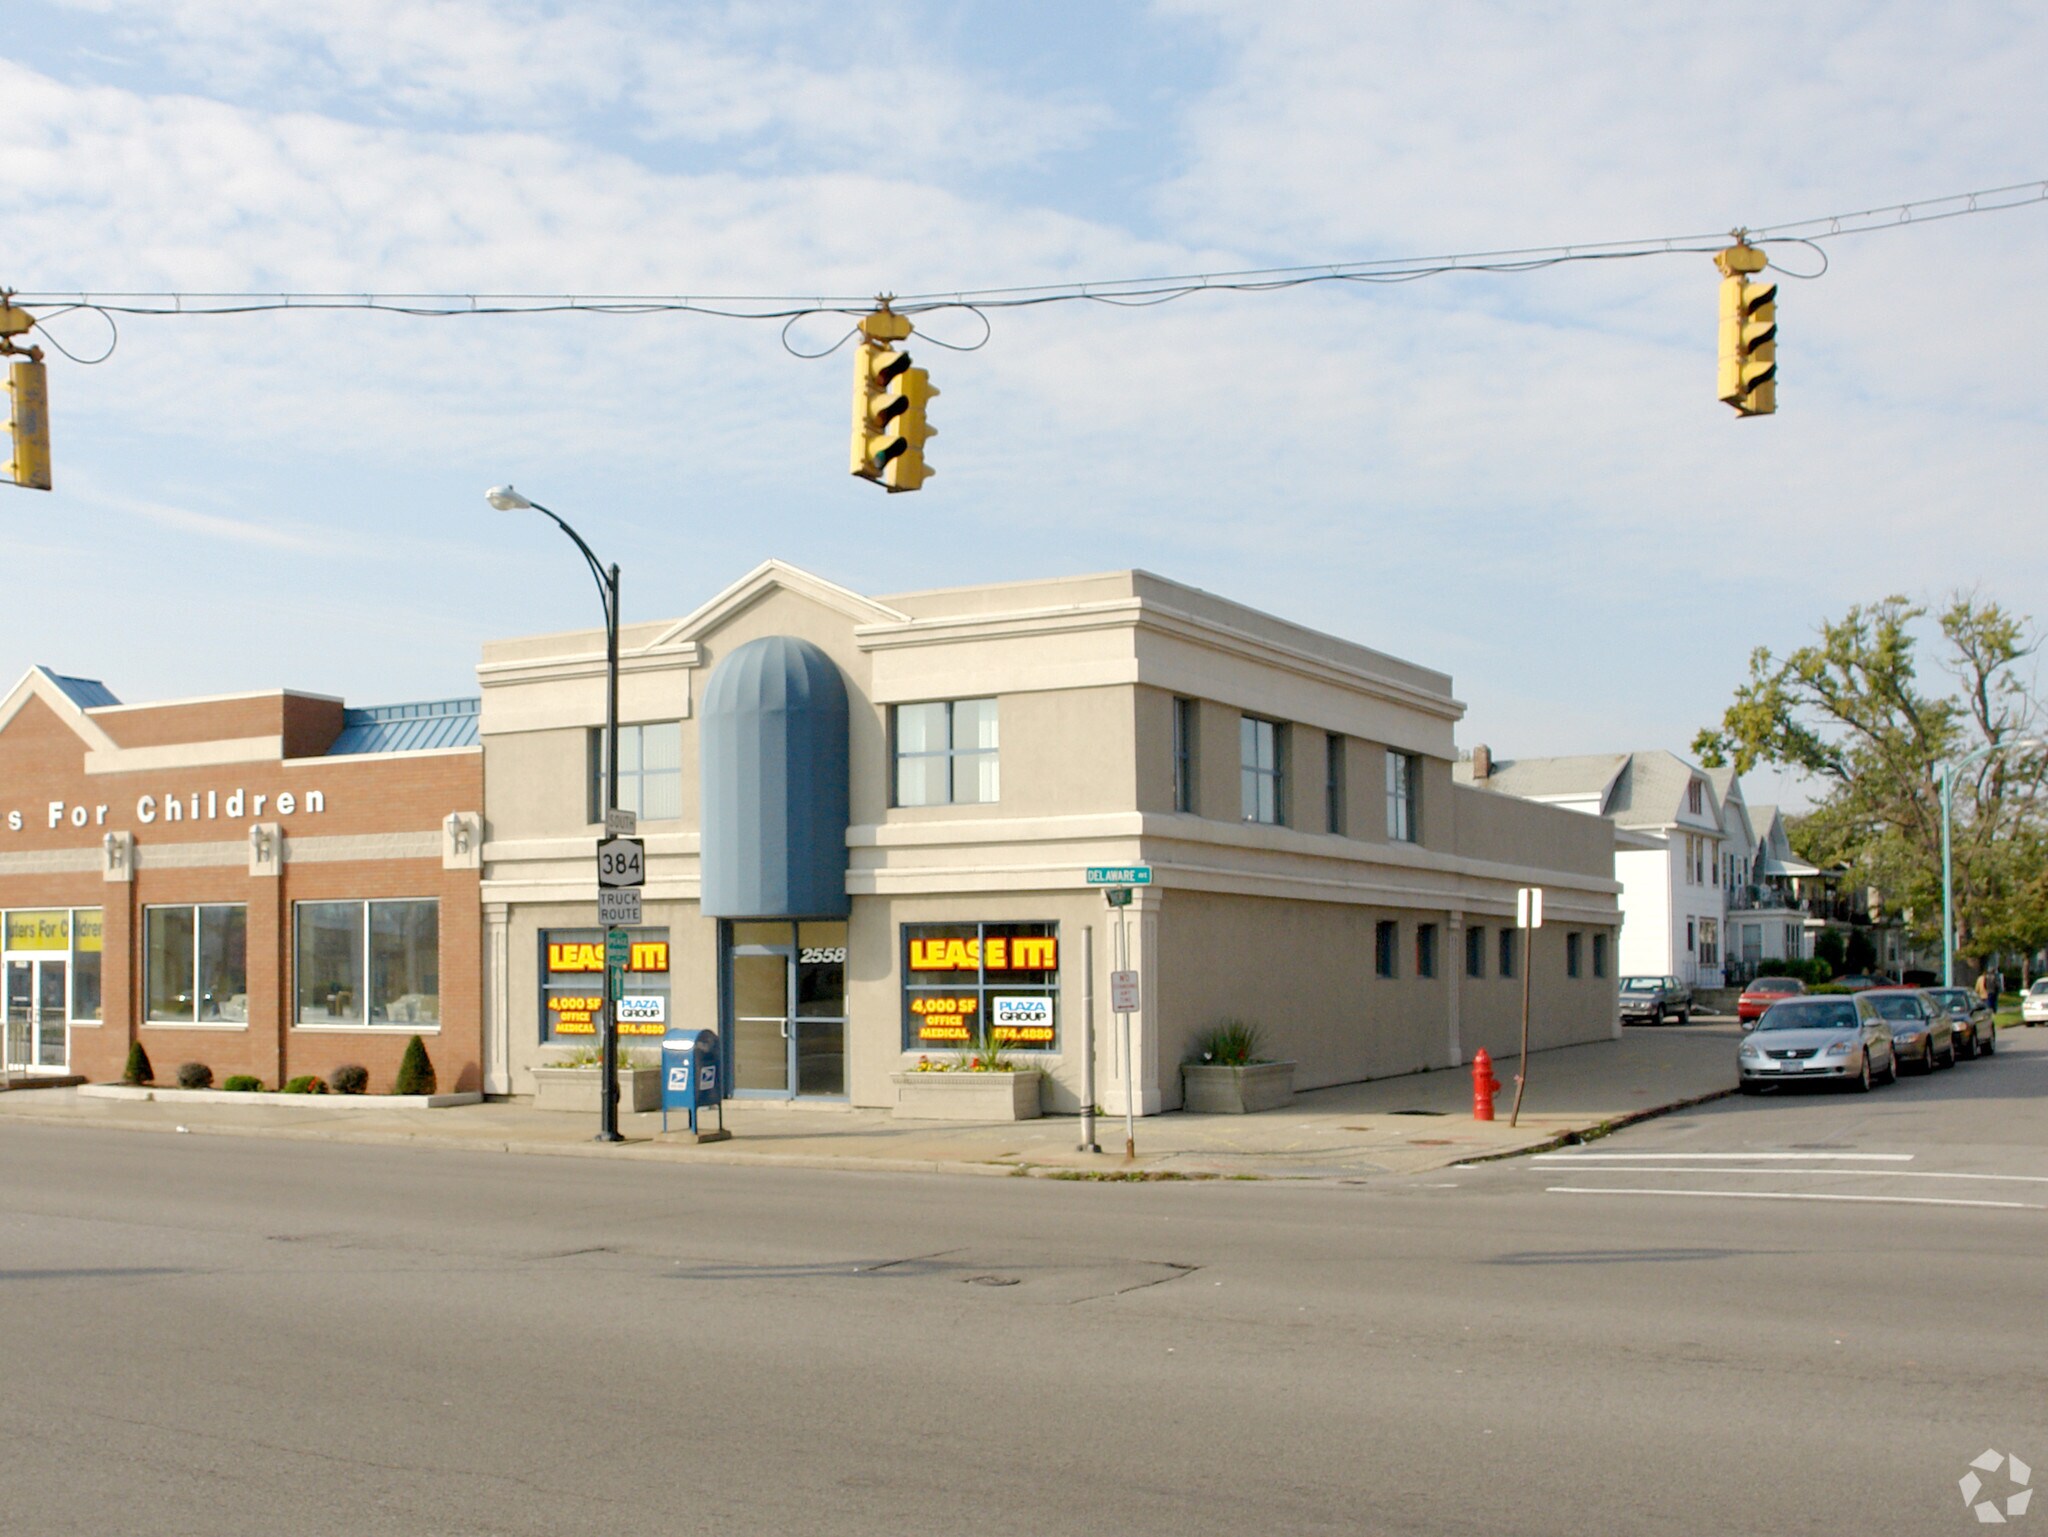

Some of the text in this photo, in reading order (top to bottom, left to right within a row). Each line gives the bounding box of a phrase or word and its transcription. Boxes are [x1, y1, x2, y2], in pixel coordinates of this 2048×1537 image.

[48, 801, 109, 829] For
[136, 788, 325, 823] Children
[609, 814, 634, 828] SOUTH
[602, 853, 640, 875] 384
[1087, 869, 1136, 882] DELAWARE
[600, 893, 640, 905] TRUCK
[601, 908, 640, 920] ROUTE
[38, 919, 57, 938] For
[548, 942, 628, 972] LEAS
[631, 942, 668, 972] IT!
[800, 947, 847, 964] 2558
[910, 937, 1057, 971] LEASE IT!
[548, 996, 602, 1011] 4,000 SF
[621, 1000, 660, 1009] PLAZA
[911, 998, 978, 1014] 4,000 SF
[999, 1001, 1046, 1011] PLAZA
[560, 1011, 591, 1022] OFFICE
[622, 1009, 660, 1018] GROUP
[1000, 1012, 1047, 1021] GROUP
[925, 1015, 964, 1026] OFFICE
[555, 1023, 596, 1034] MEDICAL
[919, 1028, 970, 1039] MEDICAL
